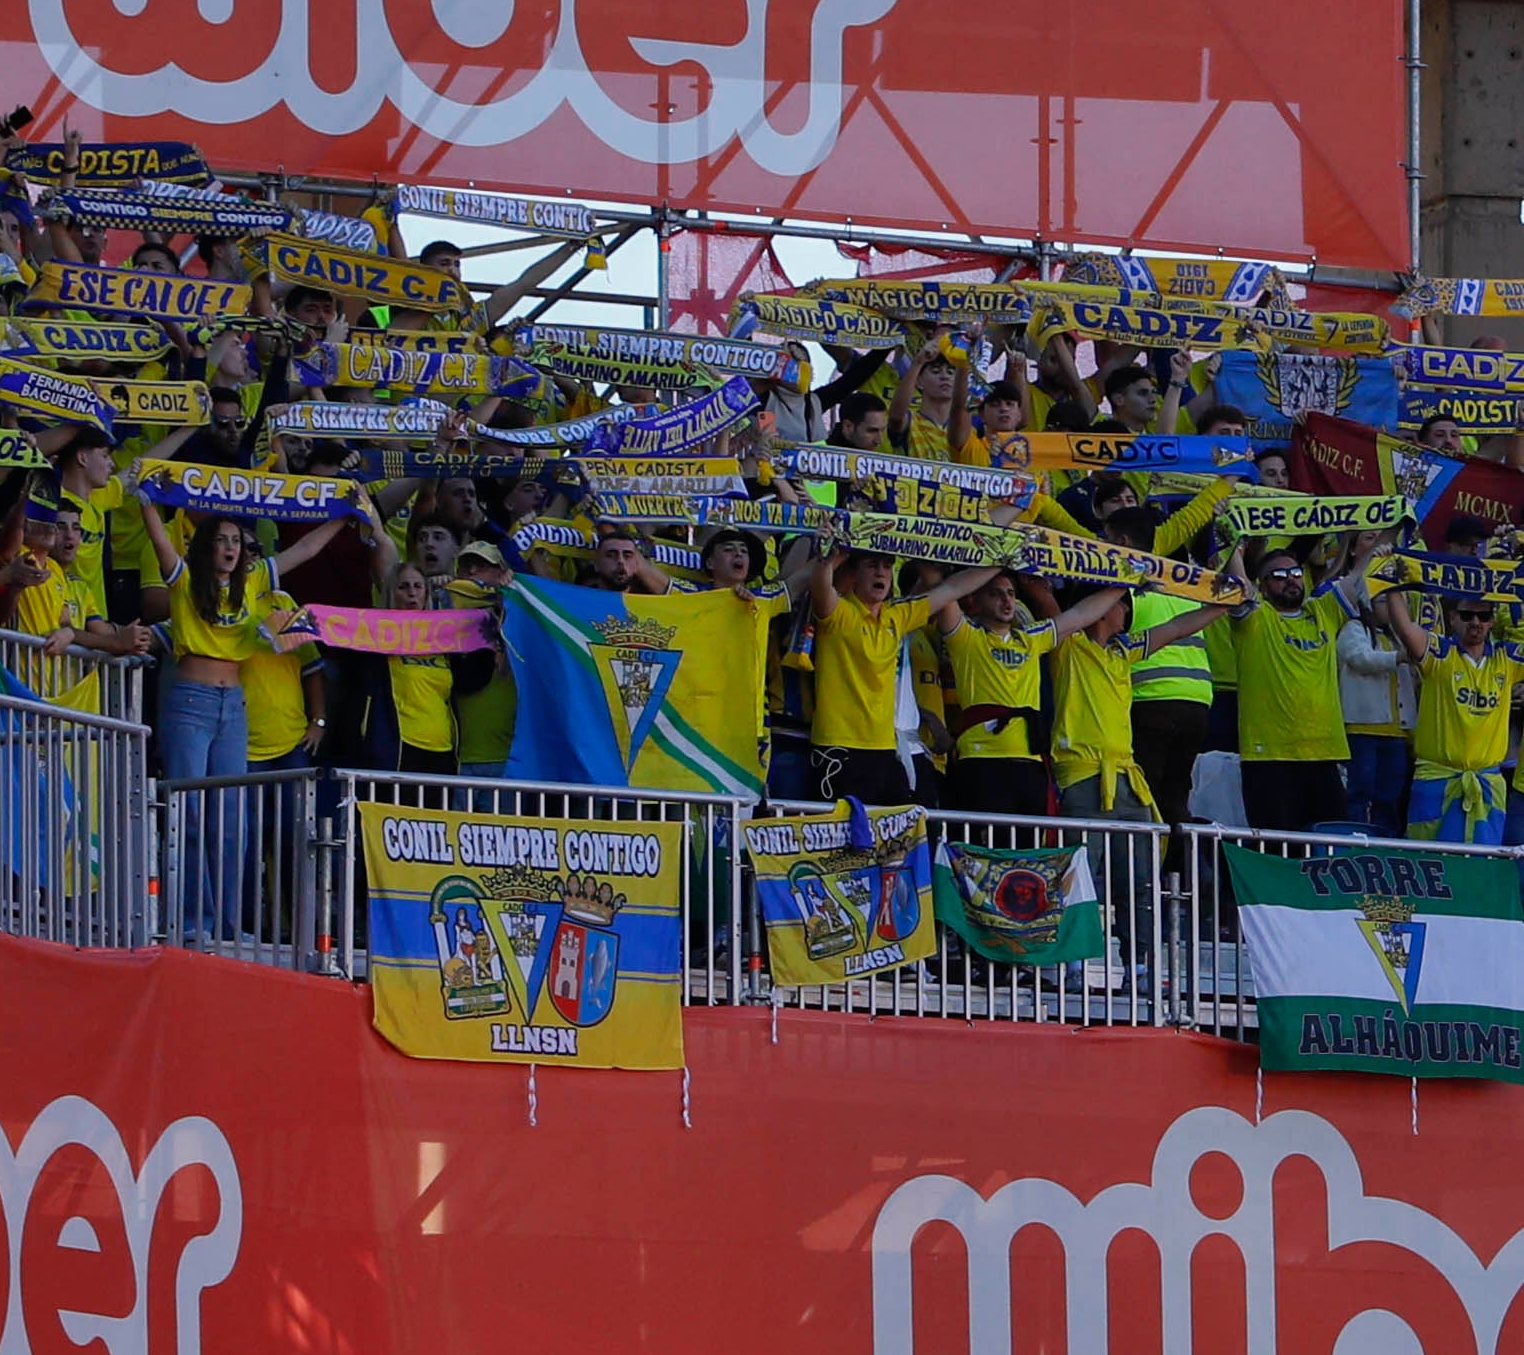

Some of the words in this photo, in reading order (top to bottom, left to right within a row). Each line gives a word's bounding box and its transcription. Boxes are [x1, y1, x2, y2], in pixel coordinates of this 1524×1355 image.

[81, 202, 146, 220] CONTIGO
[151, 207, 213, 223] SIEMPRE
[216, 211, 284, 227] CONTIGO
[845, 283, 939, 310] MÁGICO
[946, 286, 1017, 315] CÁDIZ
[1073, 304, 1223, 342] CADIZ
[593, 331, 682, 364] SIEMPRE
[685, 335, 776, 372] CONTIGO
[28, 372, 99, 403] FERNANDO
[138, 390, 189, 412] CADIZ
[310, 405, 390, 431] SIEMPRE
[1075, 438, 1179, 463] CADYC
[588, 462, 626, 475] PEÑA
[635, 462, 707, 476] CADISTA
[797, 451, 851, 475] CONIL
[855, 457, 931, 484] SIEMPRE
[936, 468, 1013, 497] CONTIGO
[1454, 490, 1513, 526] MCMX
[868, 532, 927, 557] SUBMARINO
[929, 543, 984, 565] AMARILLO
[382, 816, 455, 863] CONIL
[458, 822, 560, 872] SIEMPRE
[564, 828, 662, 876] CONTIGO
[1300, 857, 1455, 901] TORRE
[844, 945, 906, 976] LLNSN
[490, 1023, 579, 1056] LLNSN
[1298, 1007, 1522, 1070] ALHÁQUIME
